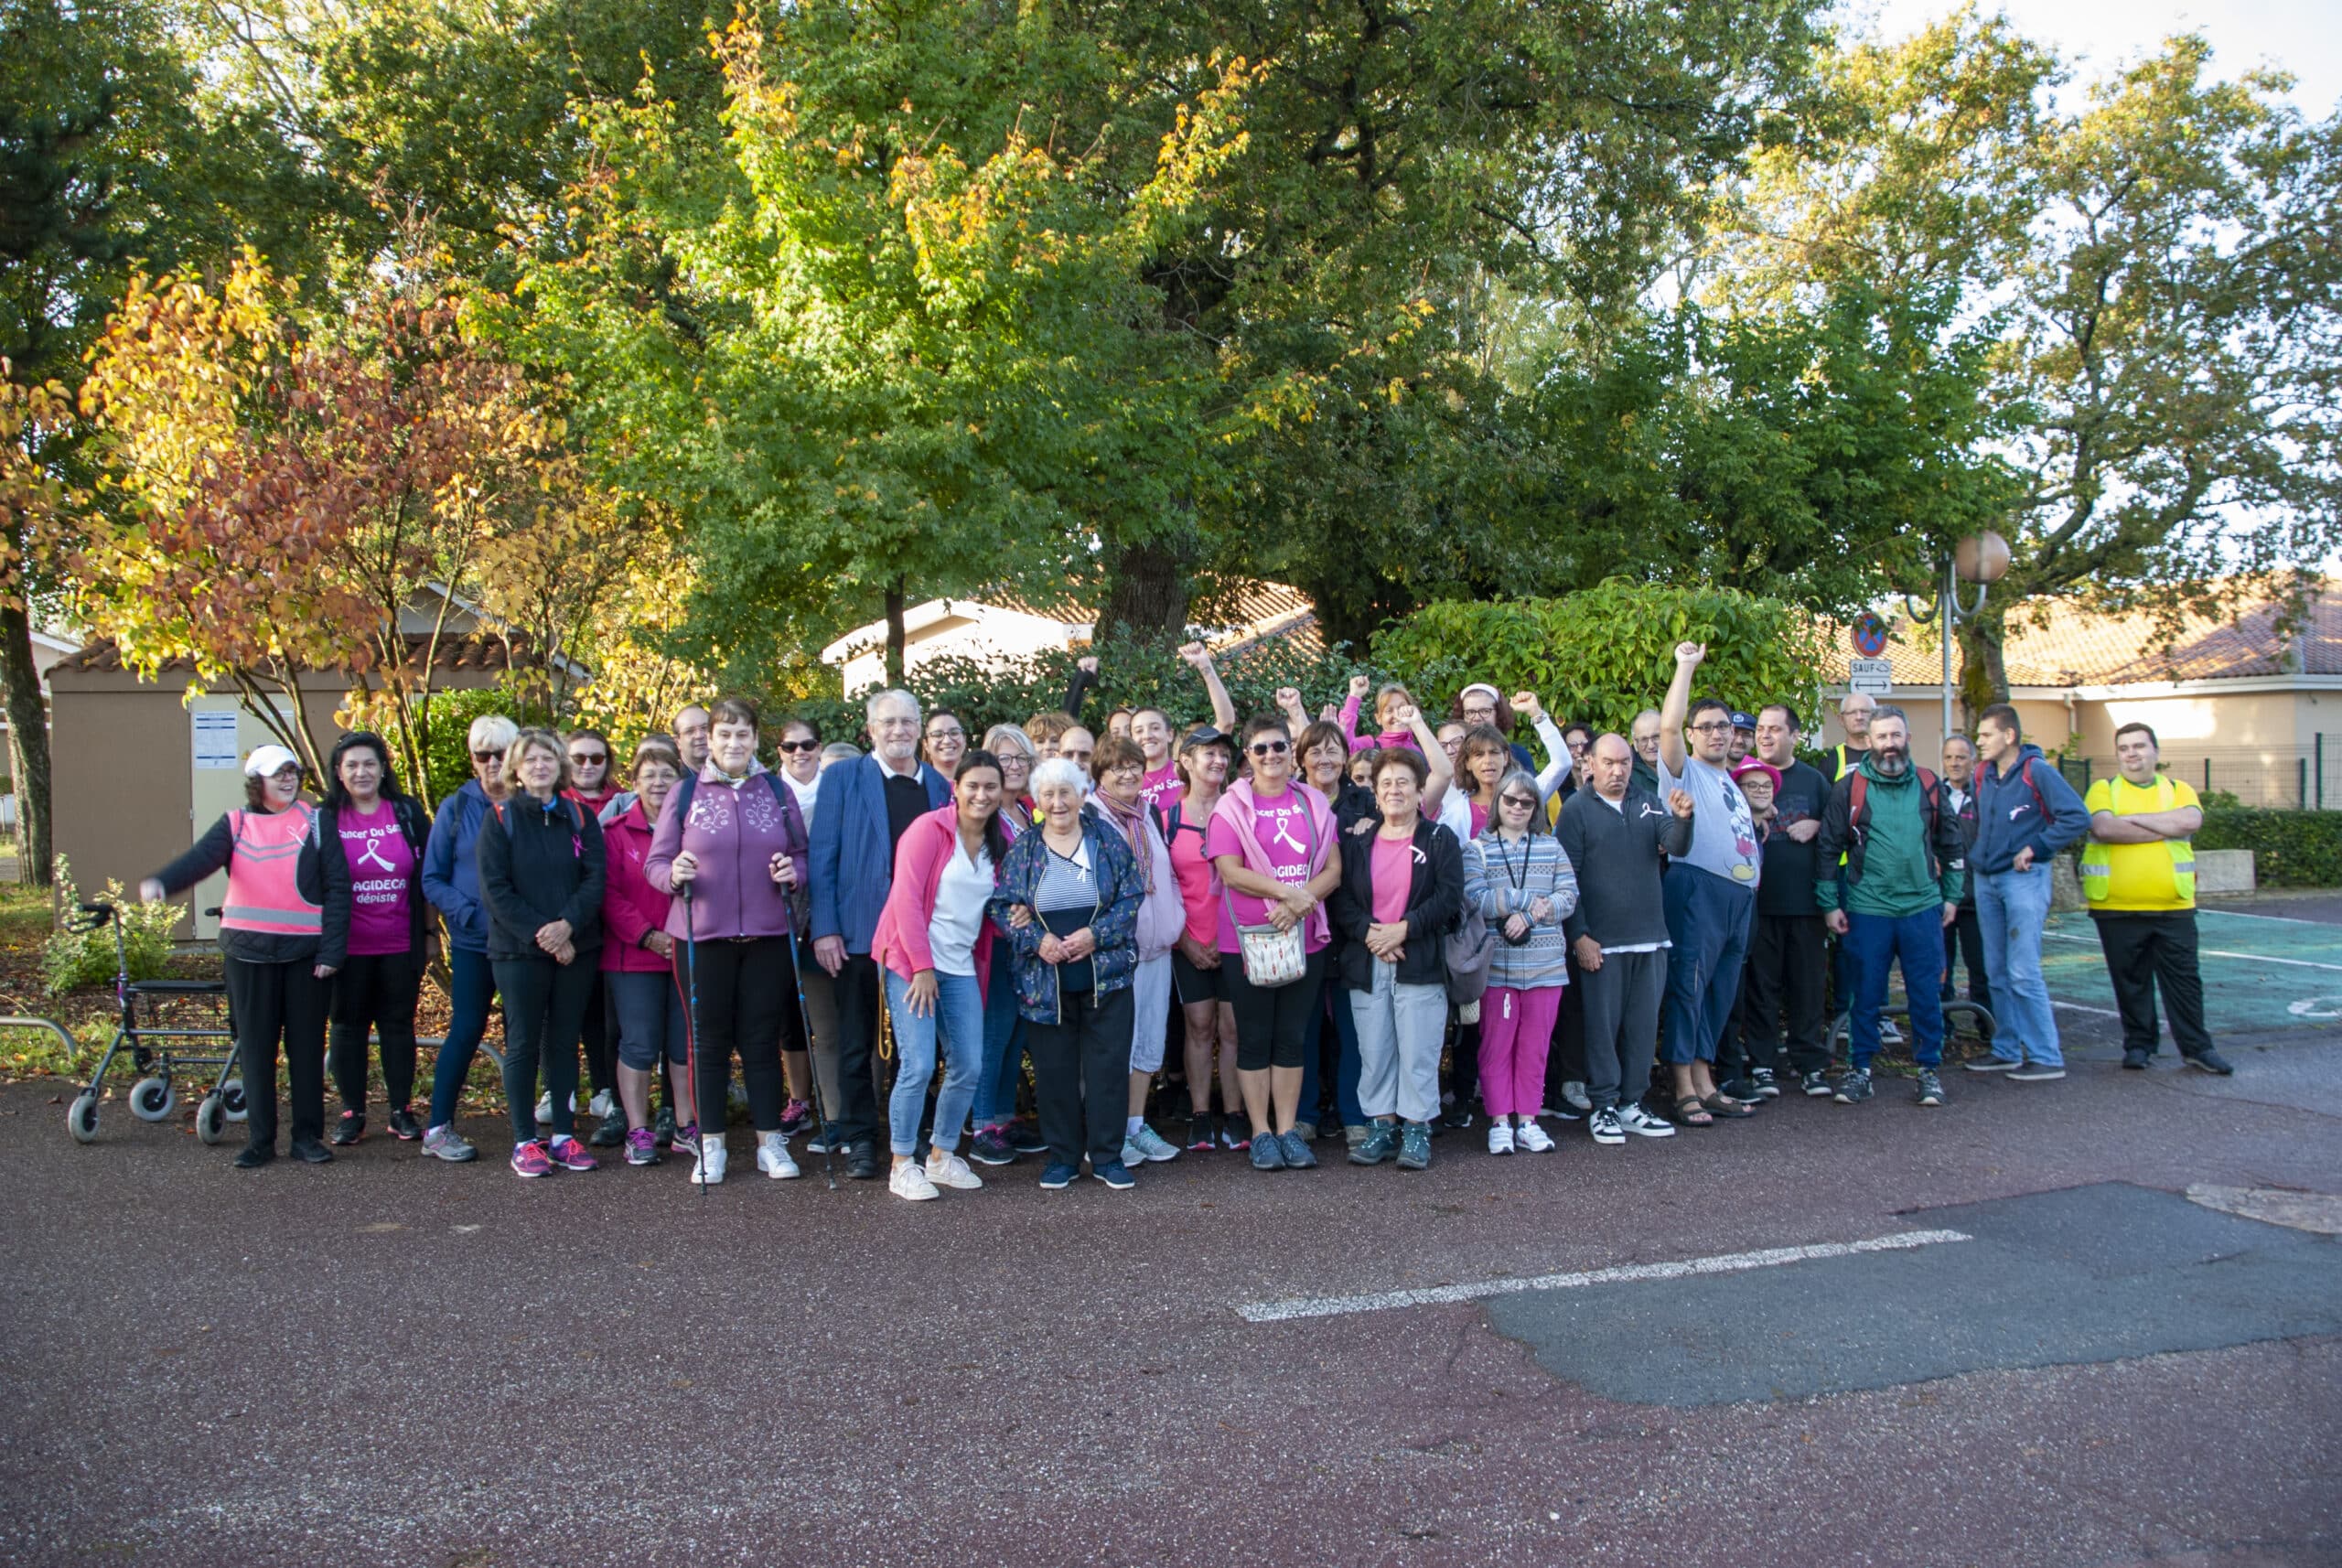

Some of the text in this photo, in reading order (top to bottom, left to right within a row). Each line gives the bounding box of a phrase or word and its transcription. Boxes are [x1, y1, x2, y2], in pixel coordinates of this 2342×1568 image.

[1853, 663, 1875, 673] SAUF
[1276, 808, 1292, 817] Du
[369, 827, 385, 837] Du
[352, 878, 406, 892] AGIDECA
[357, 893, 397, 904] dépiste
